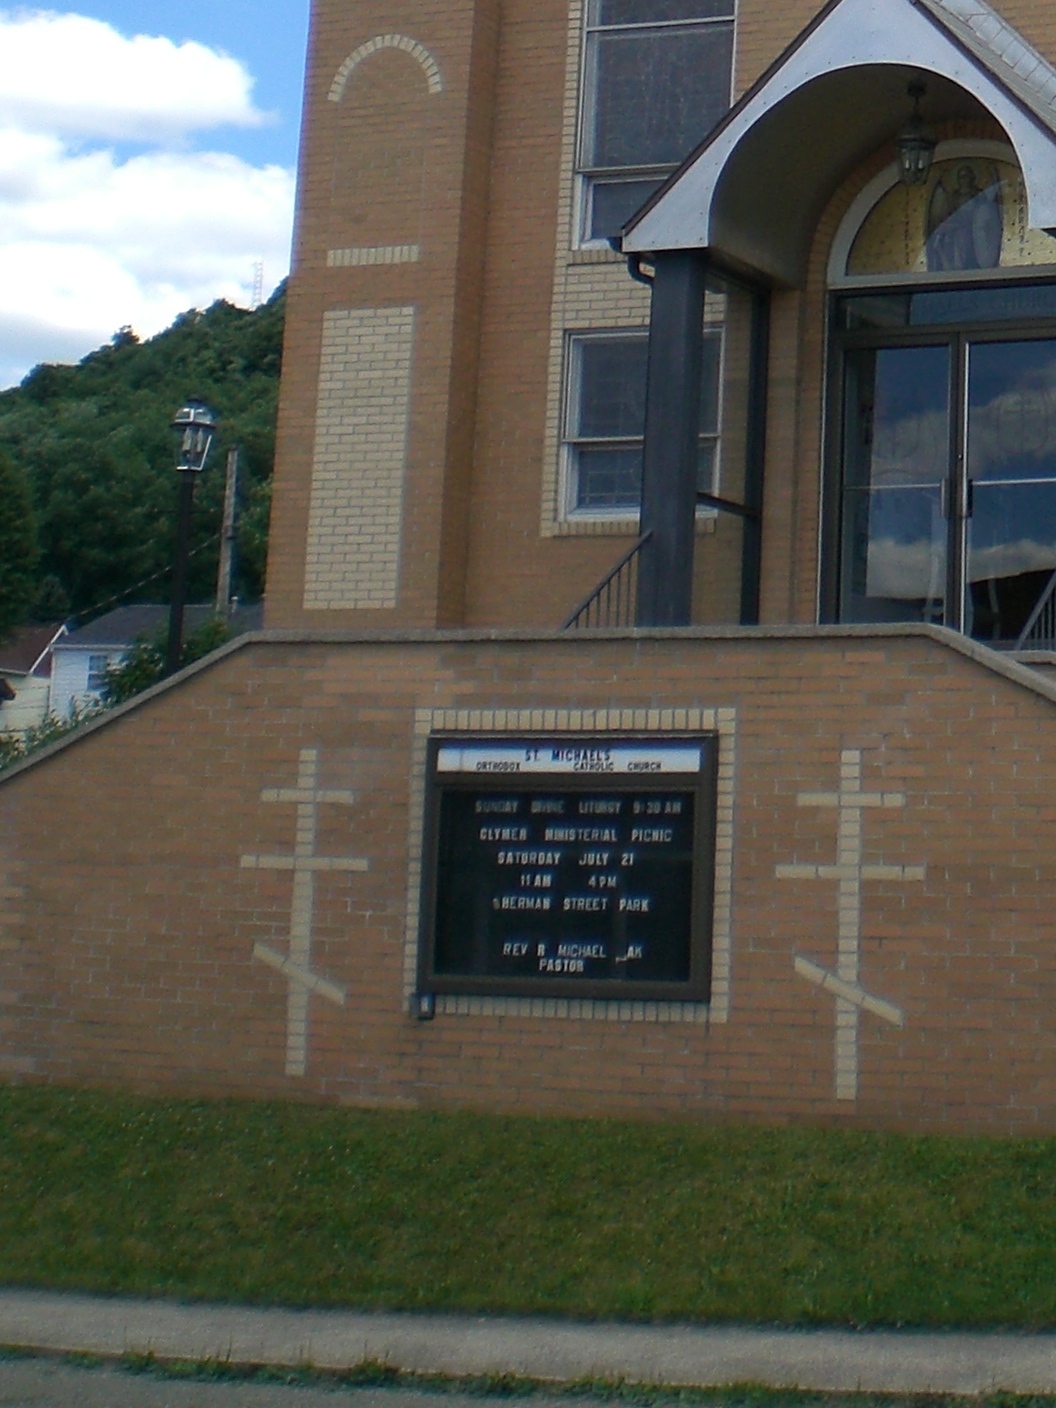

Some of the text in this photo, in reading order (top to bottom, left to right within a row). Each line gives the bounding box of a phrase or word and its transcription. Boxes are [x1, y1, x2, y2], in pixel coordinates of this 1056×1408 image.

[476, 761, 662, 772] ORTHODOX CATHOLIC CHURCH
[475, 800, 519, 814] SUNDAY
[578, 800, 621, 814] LITURGY
[479, 827, 673, 843] CLYMER MINISTERIAL PICNIC
[497, 852, 634, 866] SATURDAY JULY 21
[492, 897, 649, 913] SHERMAN STREET PARK
[503, 943, 528, 956] REV
[557, 944, 607, 959] MICHAEL
[539, 958, 584, 973] PASTOR
